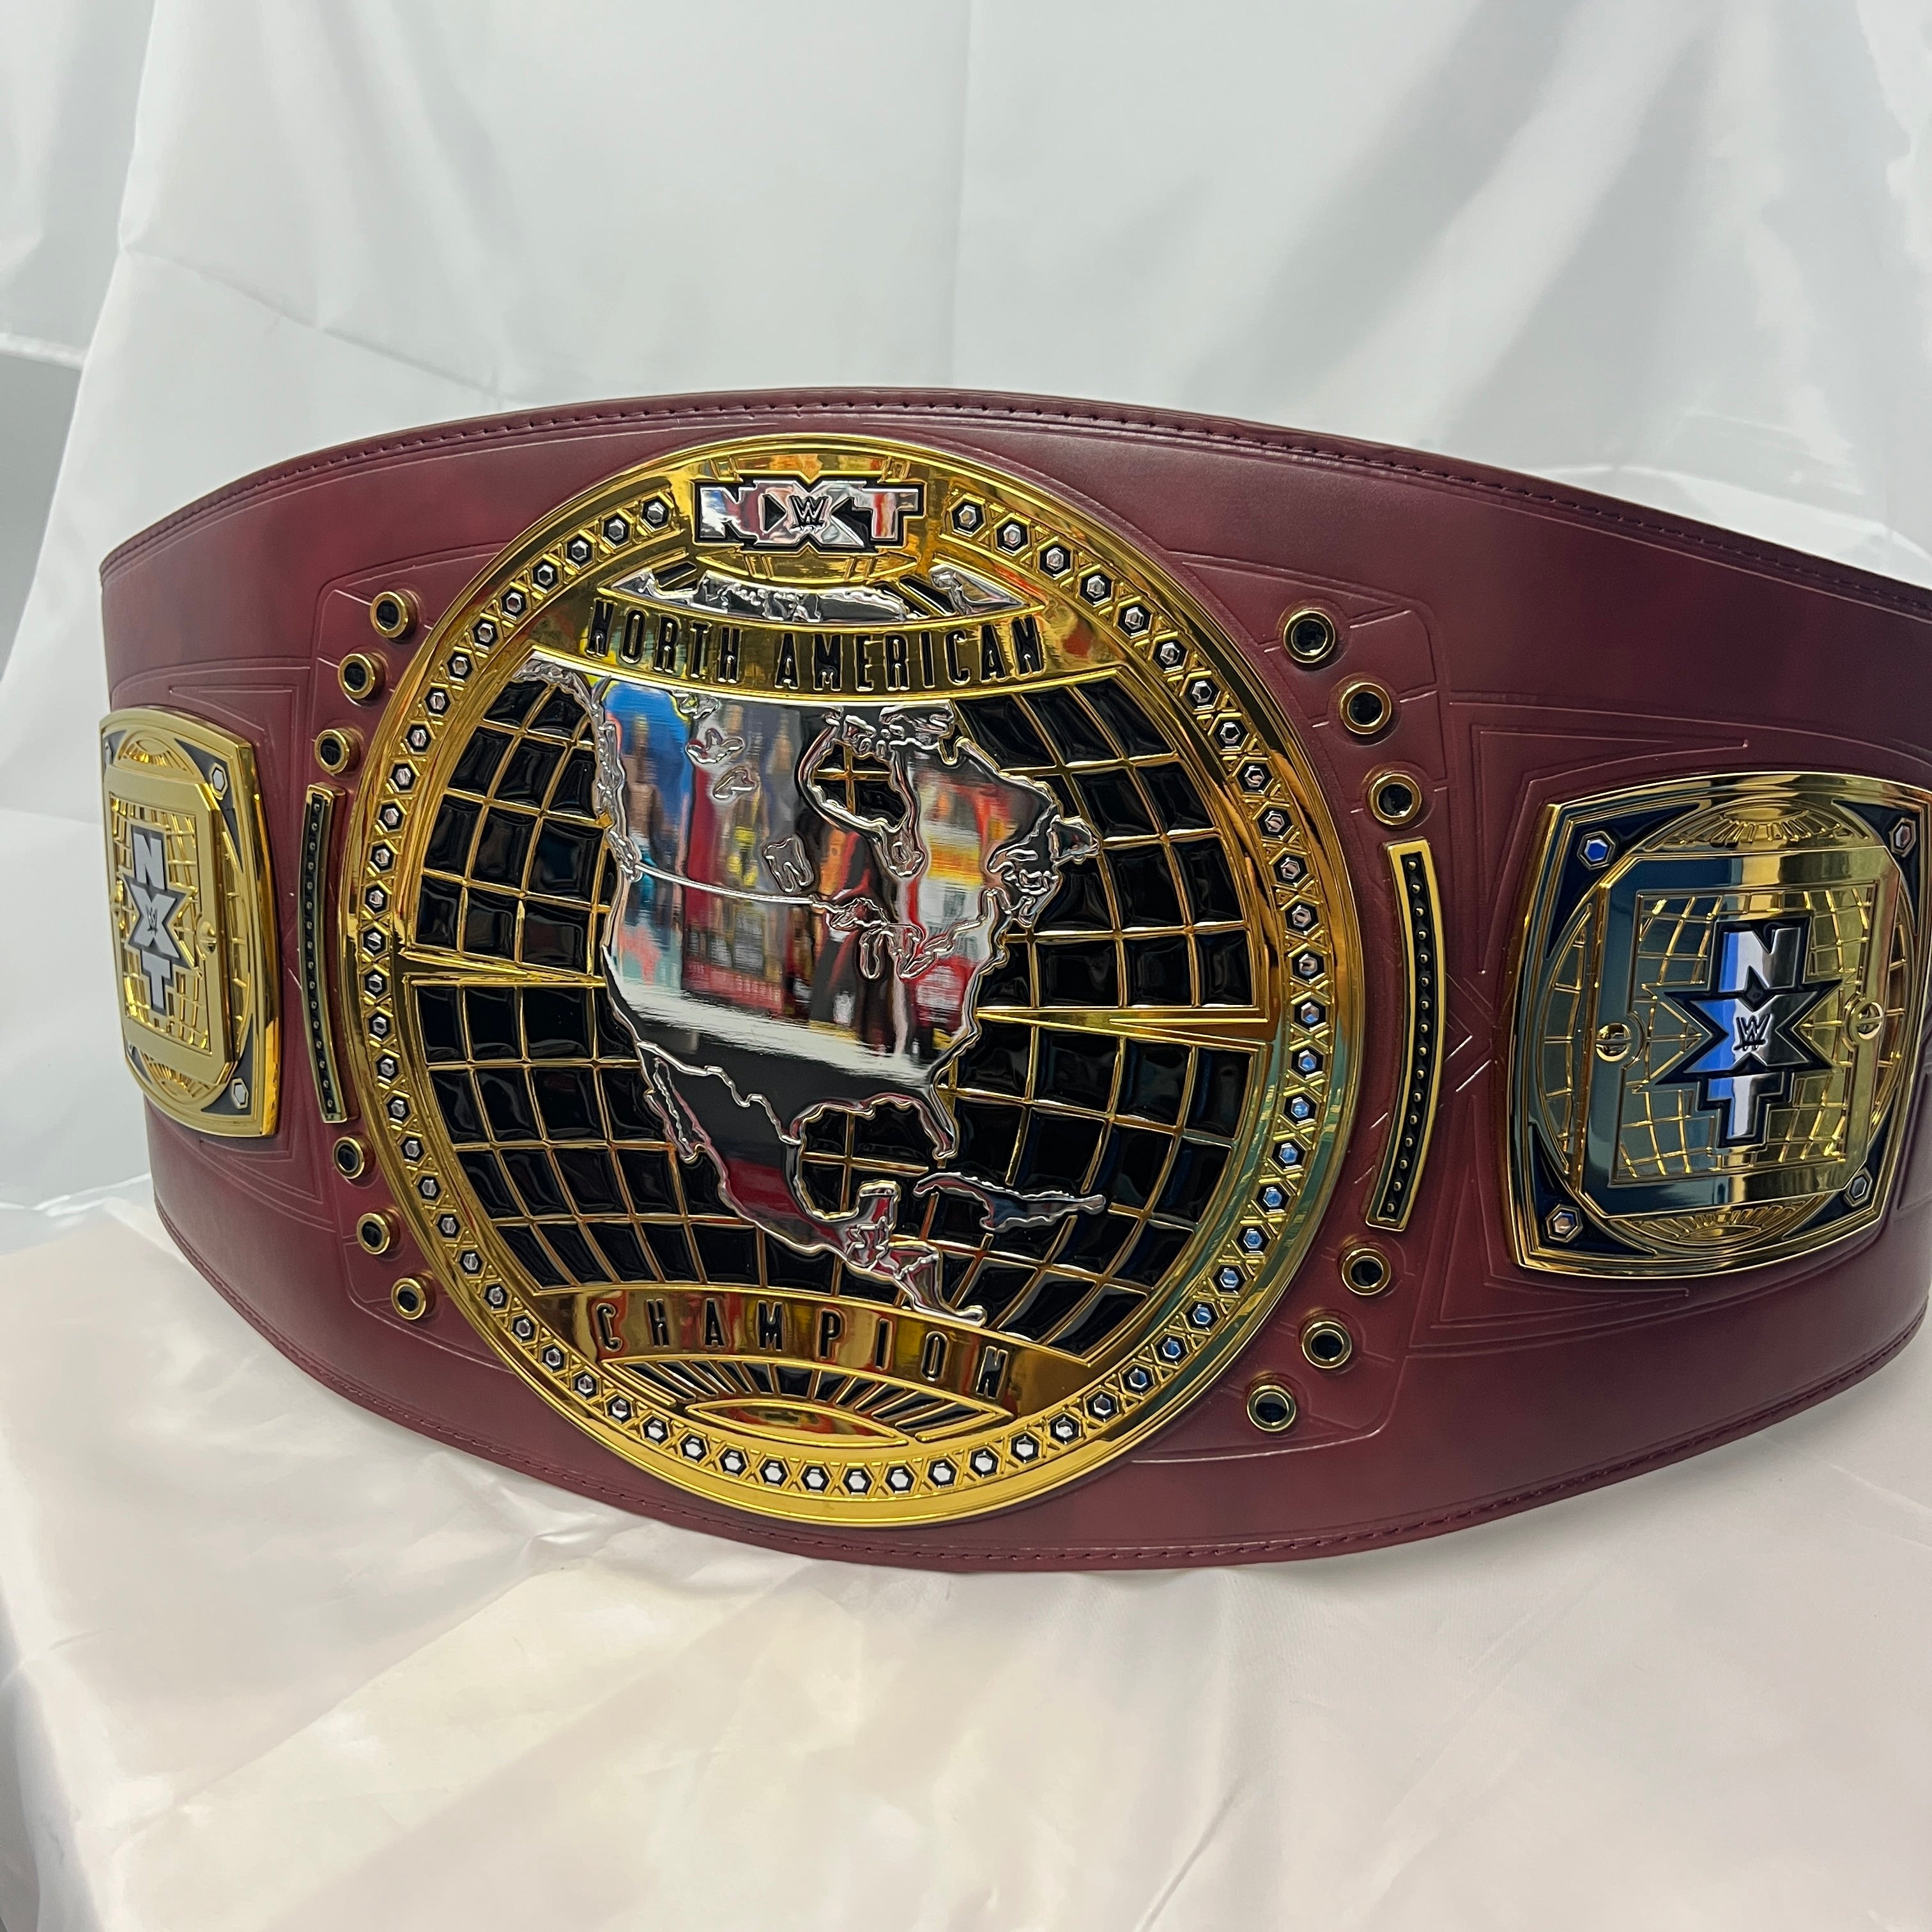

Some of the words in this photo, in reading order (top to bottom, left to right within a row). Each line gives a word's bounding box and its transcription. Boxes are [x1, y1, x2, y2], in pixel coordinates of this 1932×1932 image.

[700, 480, 922, 548] NXT
[586, 598, 743, 682] NORTH
[775, 616, 1043, 691] AMERICAN
[130, 832, 181, 1011] NXT
[1685, 926, 1819, 1140] NXT
[595, 1298, 1008, 1399] CHAMPION
